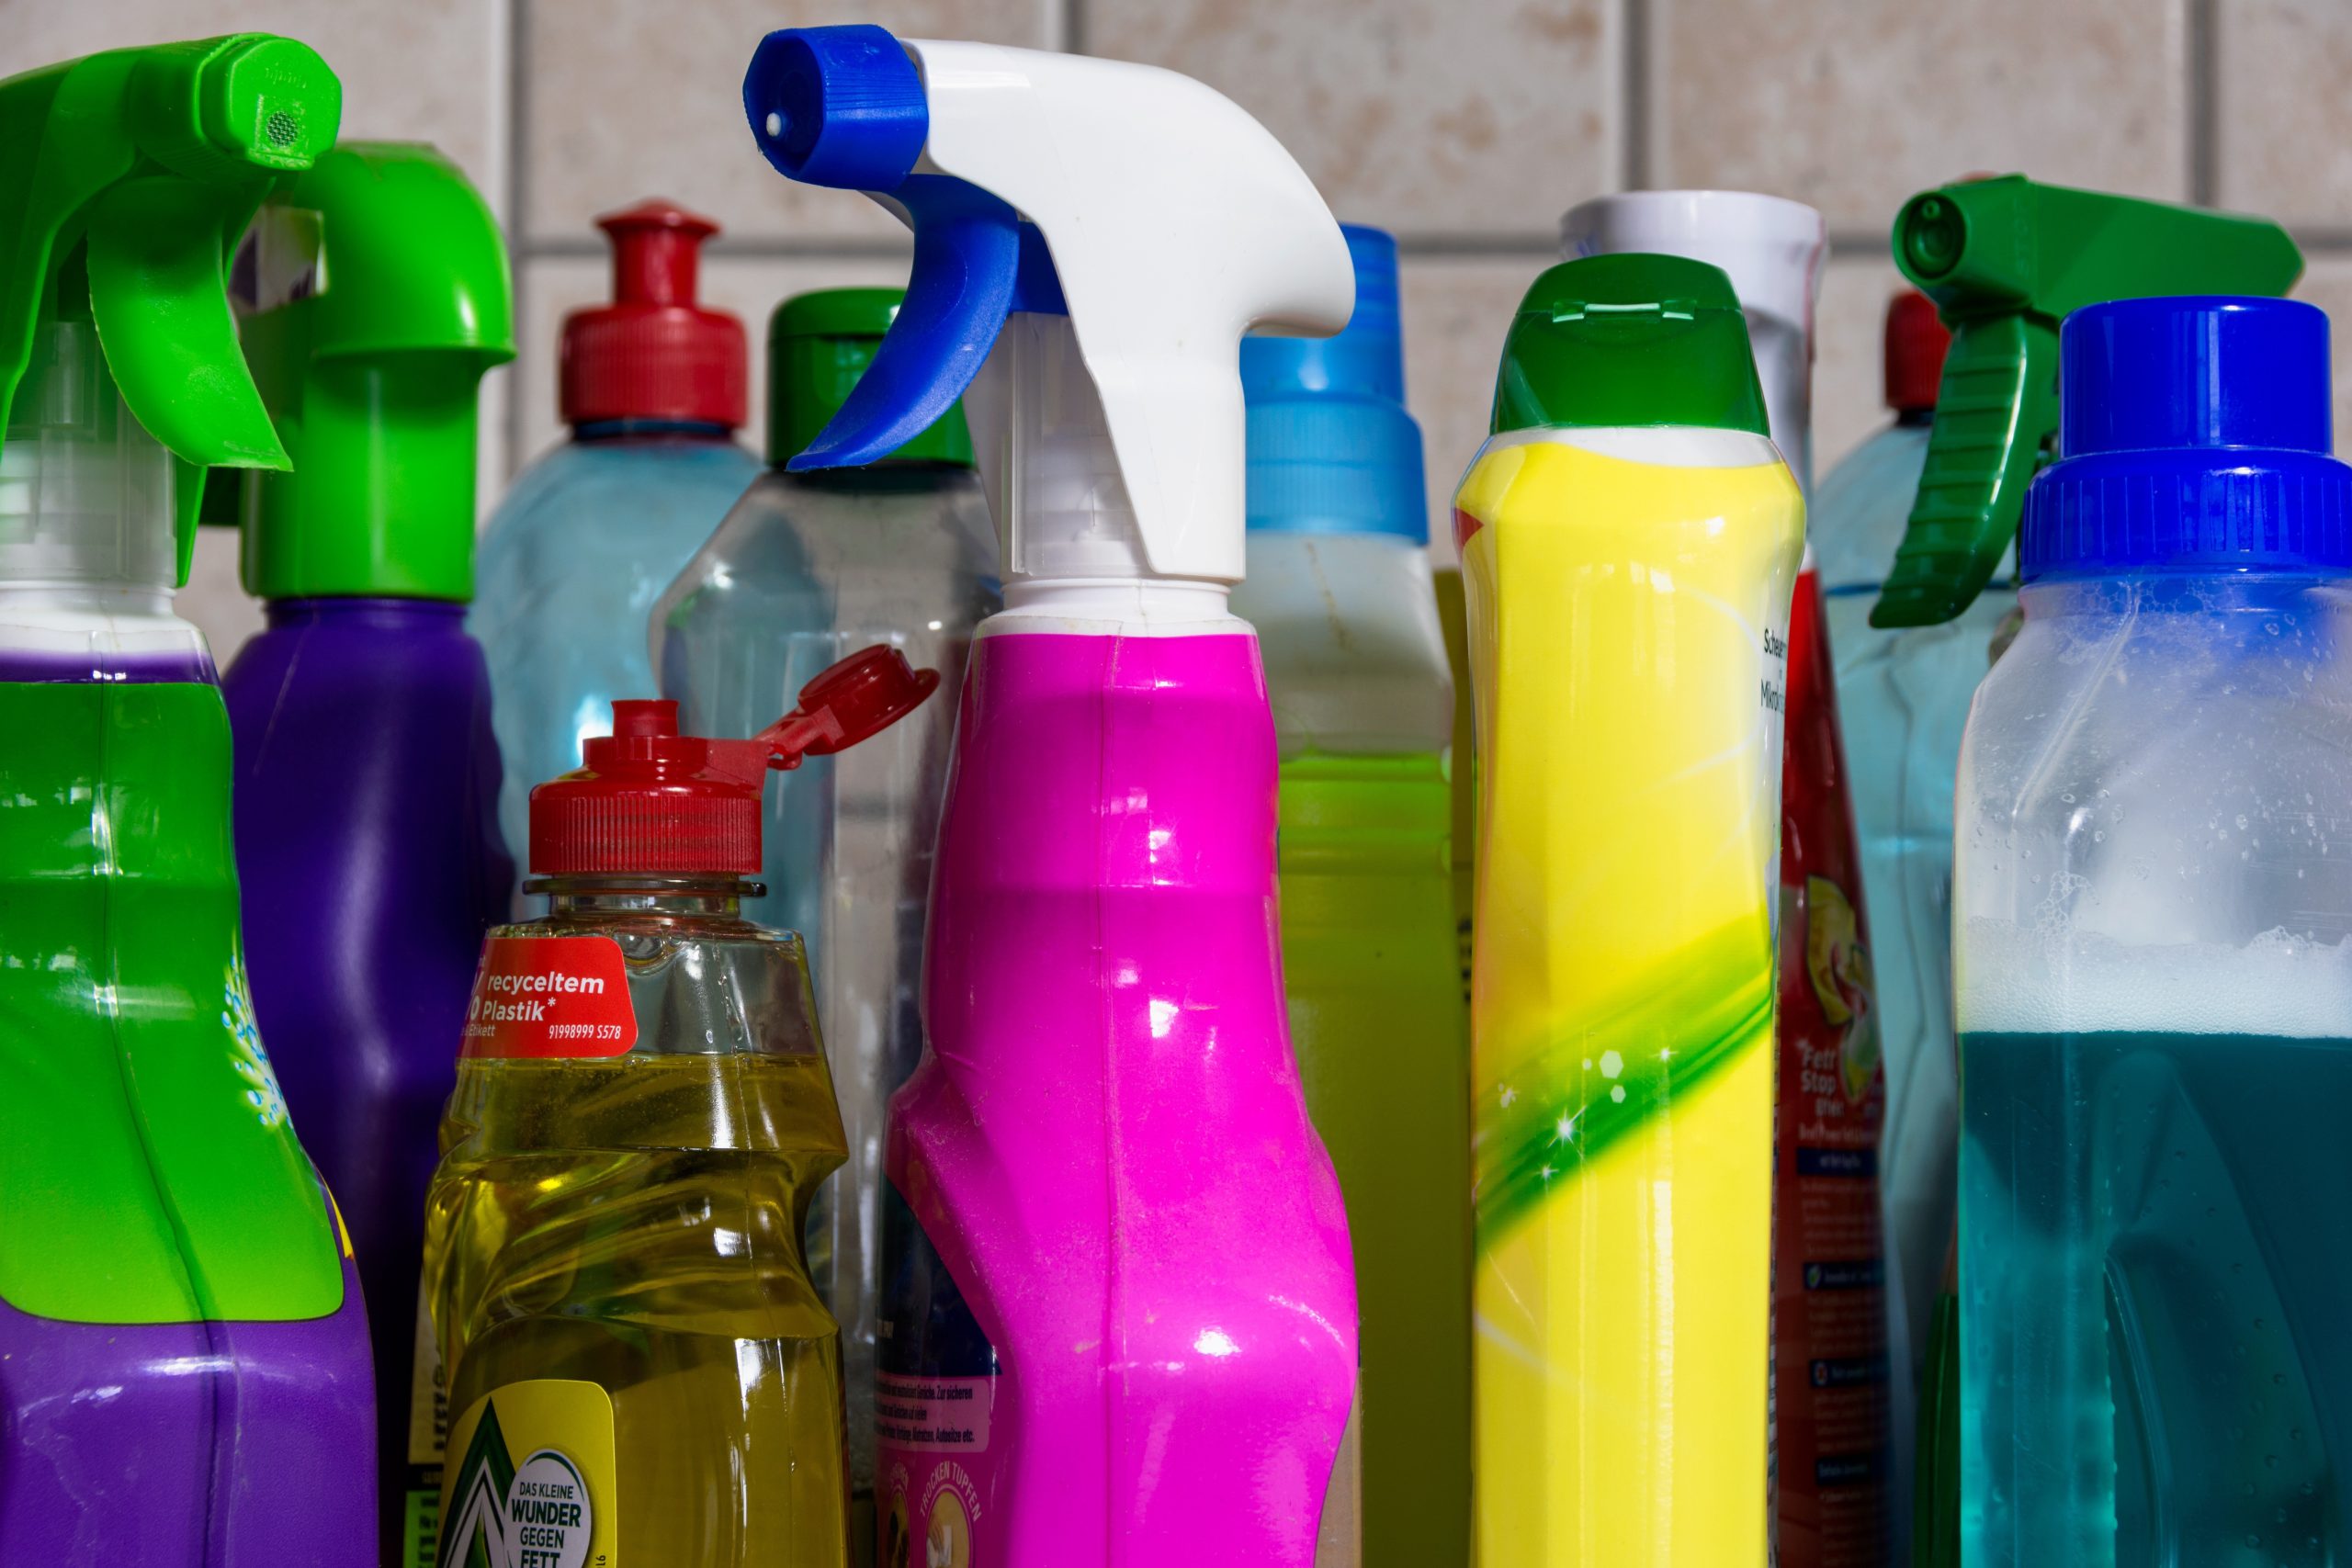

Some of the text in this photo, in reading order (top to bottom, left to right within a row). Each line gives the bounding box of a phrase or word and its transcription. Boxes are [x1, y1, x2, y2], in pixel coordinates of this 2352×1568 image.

[487, 971, 605, 996] recyceltem
[469, 1023, 495, 1037] Etikett
[548, 1024, 621, 1040] 91998999 S578
[946, 1385, 973, 1400] sicheren
[935, 1427, 962, 1442] Autositze
[962, 1429, 975, 1442] etc.
[520, 1482, 574, 1500] DAS KLEINE
[919, 1461, 950, 1517] TROCKEN
[952, 1461, 982, 1522] TUPFEN
[512, 1499, 582, 1528] WUNDER
[520, 1528, 564, 1549] GEGEN
[521, 1550, 560, 1568] FETT
